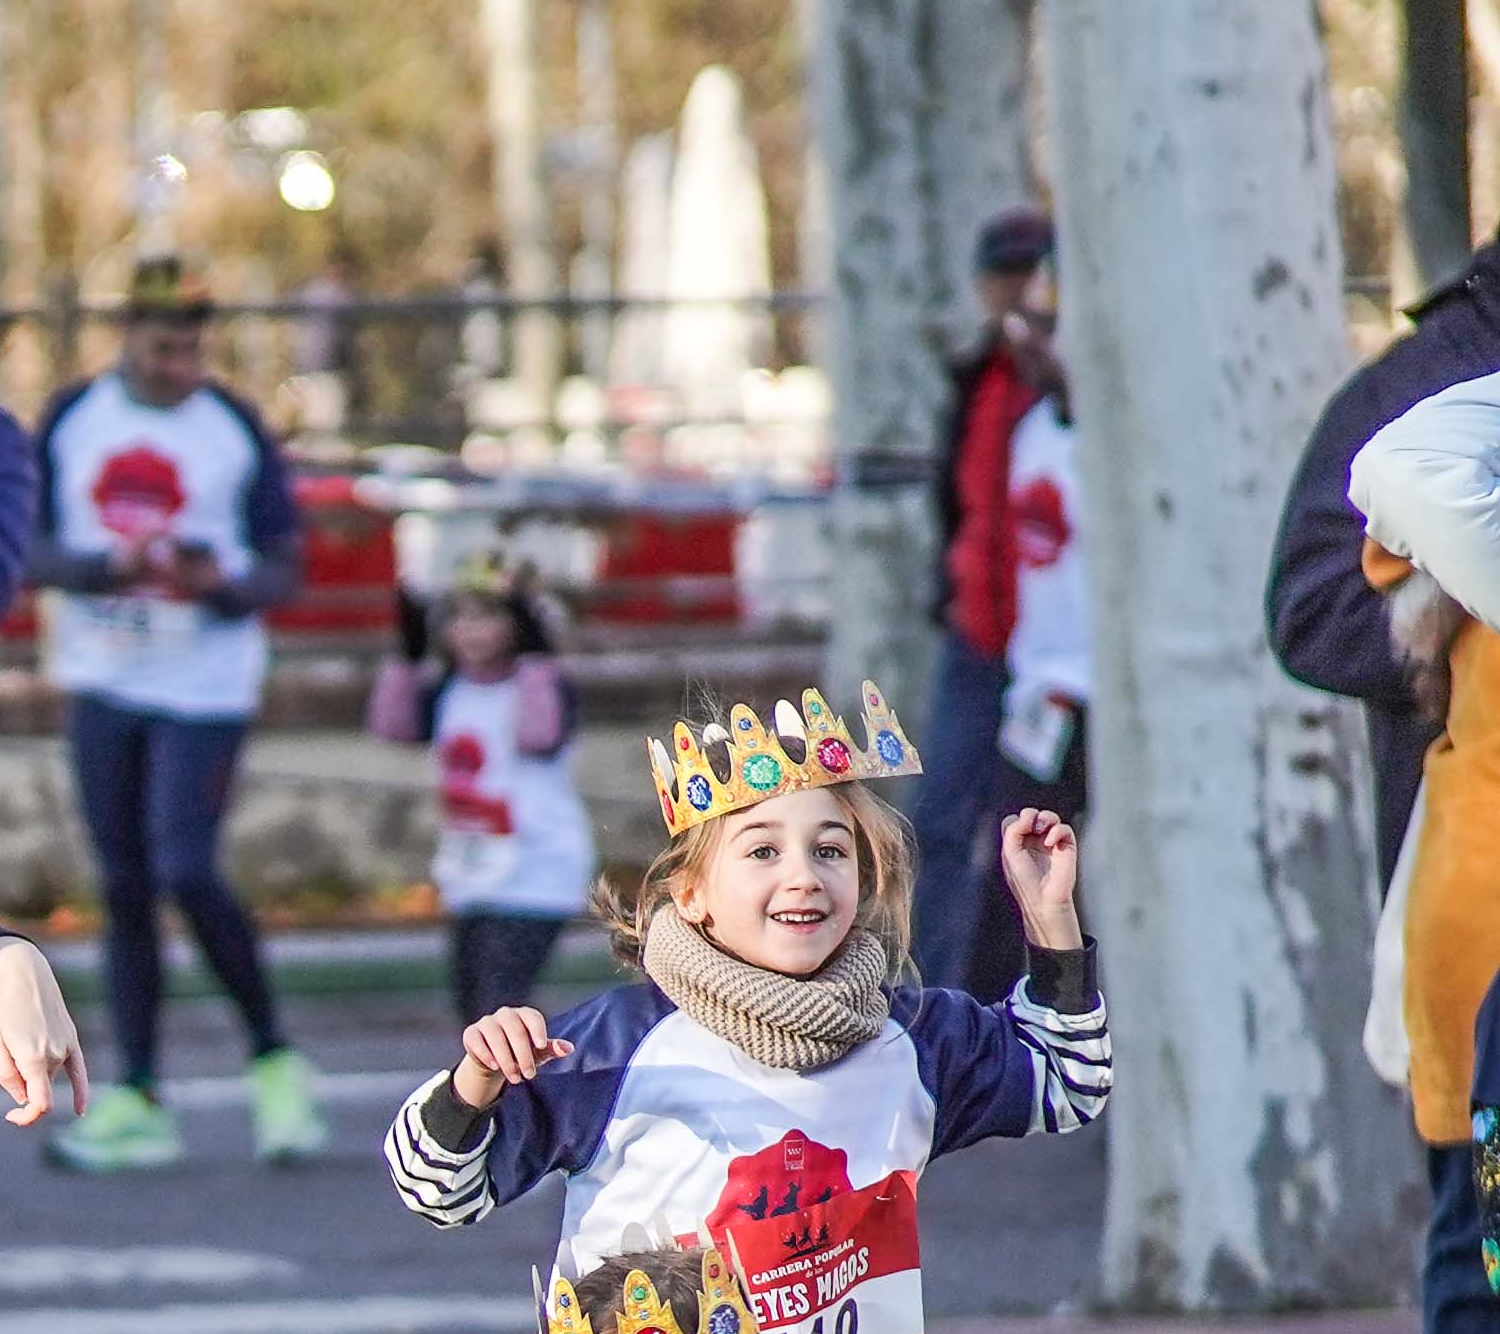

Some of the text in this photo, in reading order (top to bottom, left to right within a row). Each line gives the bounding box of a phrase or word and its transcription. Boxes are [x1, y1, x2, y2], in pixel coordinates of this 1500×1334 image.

[749, 1246, 869, 1324] EYES MAGOS
[751, 1257, 813, 1285] CARRERA
